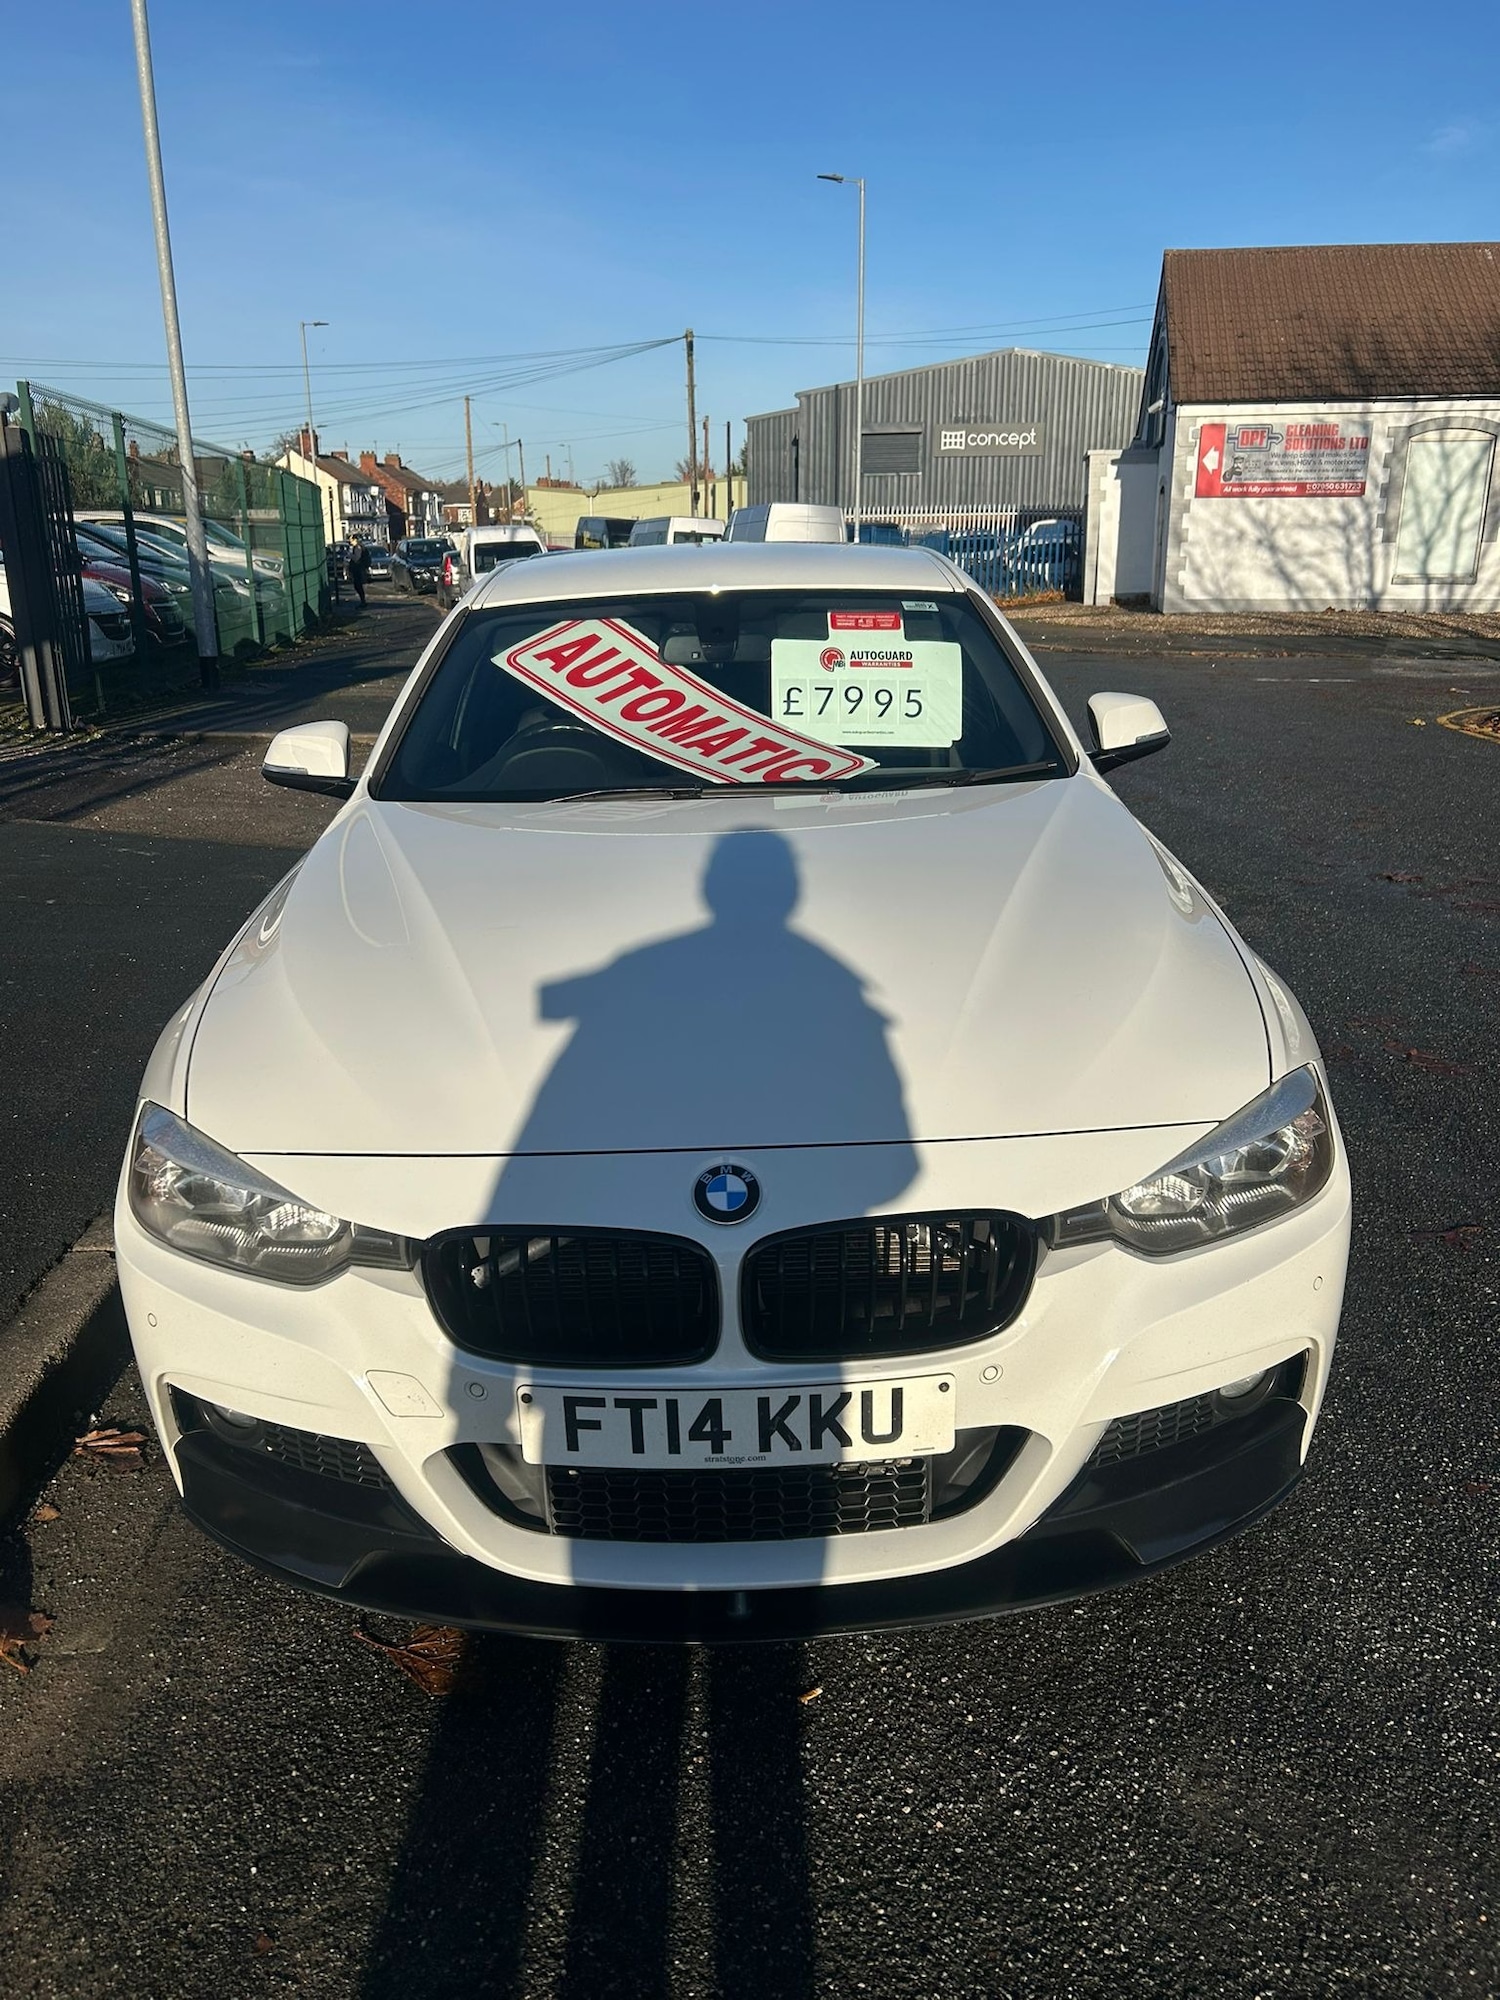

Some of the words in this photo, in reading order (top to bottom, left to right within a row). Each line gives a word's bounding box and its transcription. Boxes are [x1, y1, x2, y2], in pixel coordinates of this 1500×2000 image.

[967, 428, 1037, 450] concept
[1240, 430, 1267, 447] DPF
[1285, 424, 1340, 437] CLEANING
[1284, 437, 1345, 451] SOLUTIONS
[1349, 436, 1368, 450] LTD
[1223, 485, 1232, 493] All
[1232, 485, 1247, 493] work
[1247, 485, 1262, 494] fully
[1261, 485, 1298, 494] guaranteed
[850, 651, 913, 661] AUTOGUARD
[533, 633, 831, 782] AUTOMATIC
[783, 686, 923, 718] £7995
[700, 1166, 754, 1184] BMW
[563, 1396, 732, 1454] FT14
[757, 1386, 904, 1453] KKU
[704, 1455, 766, 1463] stratstone.com
